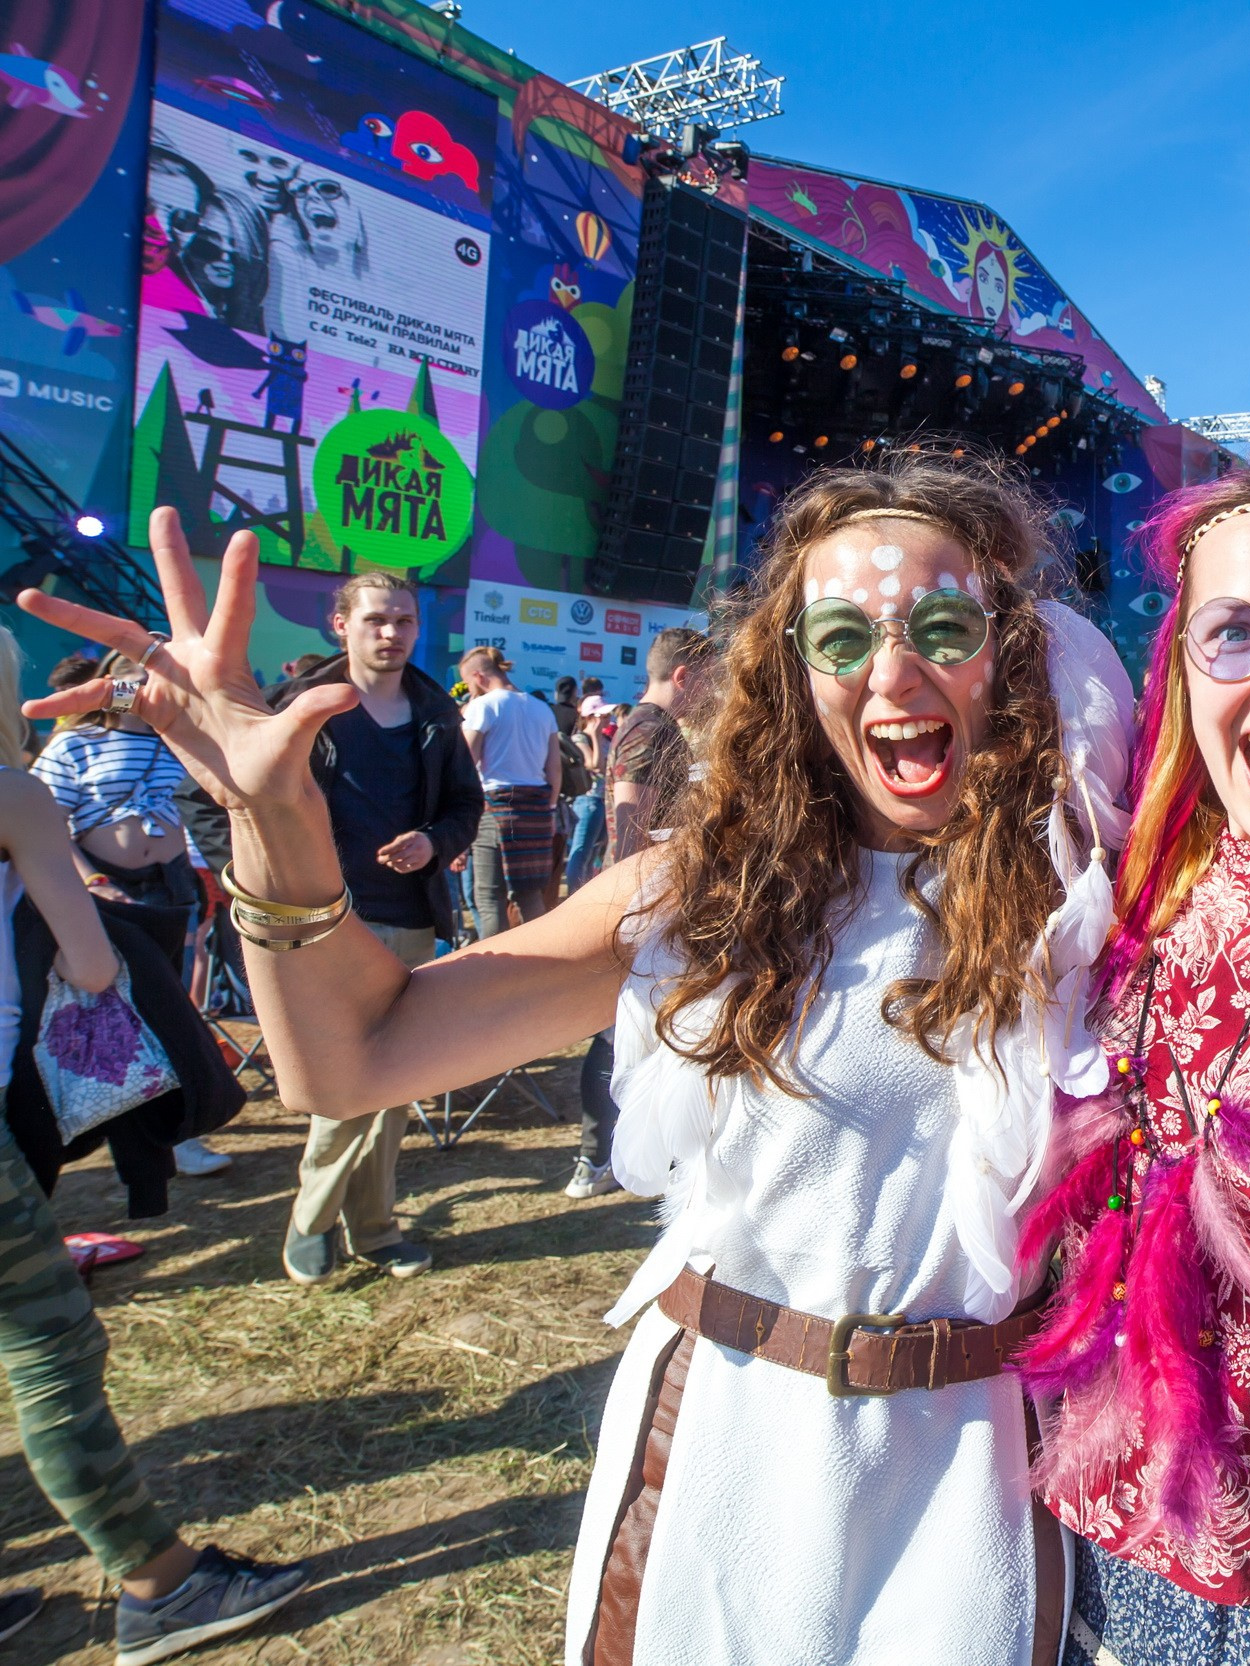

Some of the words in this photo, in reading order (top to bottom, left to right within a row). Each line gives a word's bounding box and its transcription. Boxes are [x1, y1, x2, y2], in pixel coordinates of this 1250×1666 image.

[457, 242, 479, 261] 4G
[308, 300, 330, 316] ПО
[332, 307, 390, 334] ДРУГИМ
[391, 324, 462, 355] ПРАВИЛАМ
[309, 287, 394, 321] ФЕСТИВАЛЬ
[396, 313, 442, 336] ДИКАЯ
[443, 329, 476, 347] МЯТА
[320, 324, 339, 338] 4G
[345, 330, 378, 349] Tele2
[387, 342, 407, 358] НА
[513, 328, 575, 363] ДИКАЯ
[516, 348, 579, 394] МЯТА
[27, 380, 114, 412] MUSIC
[335, 453, 442, 499] ДИКАЯ
[341, 482, 447, 542] МЯТА
[473, 610, 511, 625] Tinkoff
[527, 606, 553, 620] СТС
